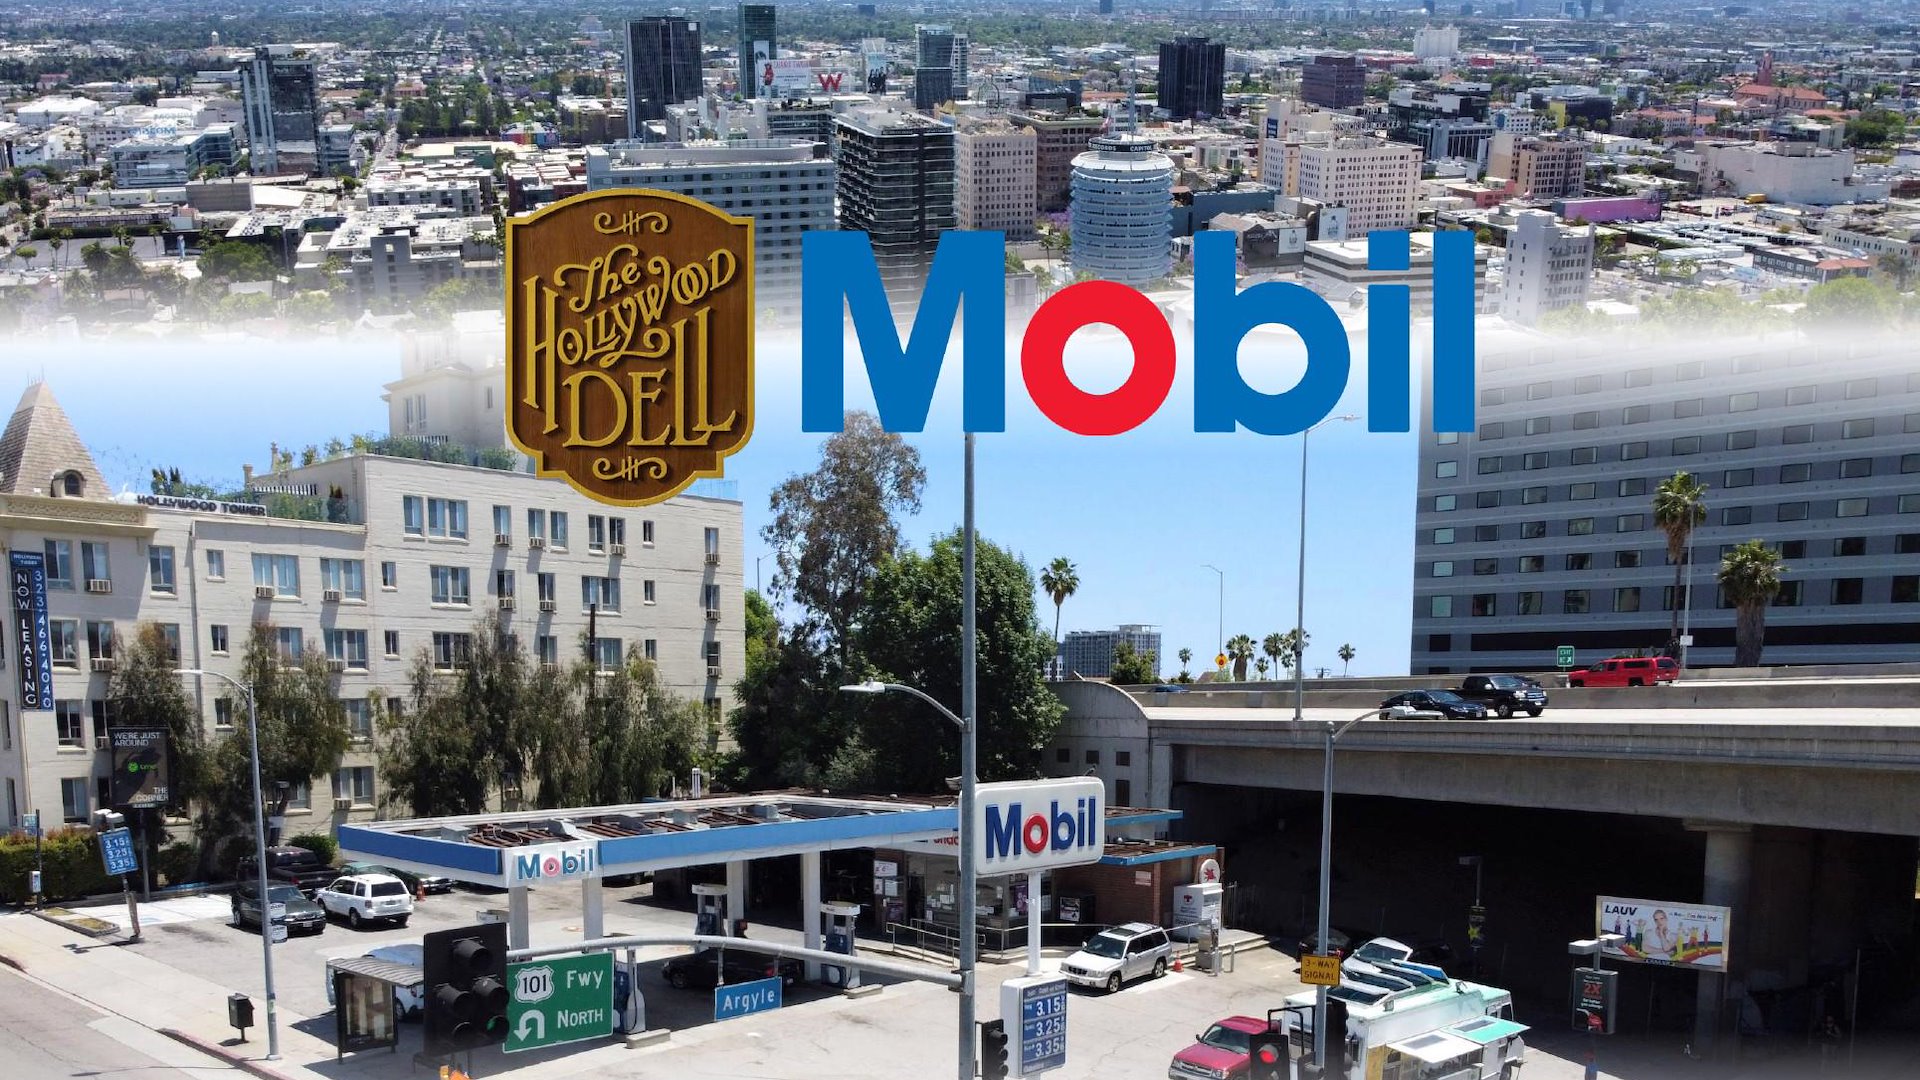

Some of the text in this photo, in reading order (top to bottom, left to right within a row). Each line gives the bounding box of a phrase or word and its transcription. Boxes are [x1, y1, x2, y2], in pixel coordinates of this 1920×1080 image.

[137, 495, 266, 516] HOLLYWOOD TOWER
[17, 573, 37, 704] NOW LEASING
[153, 786, 168, 794] THE
[985, 796, 1096, 859] Mobil
[517, 848, 594, 880] Mobil
[1605, 905, 1638, 916] LAUV
[523, 970, 604, 994] 101 Fwy
[1305, 971, 1336, 981] SIGNAL
[723, 988, 775, 1012] Argyle
[557, 1008, 604, 1029] NORTH
